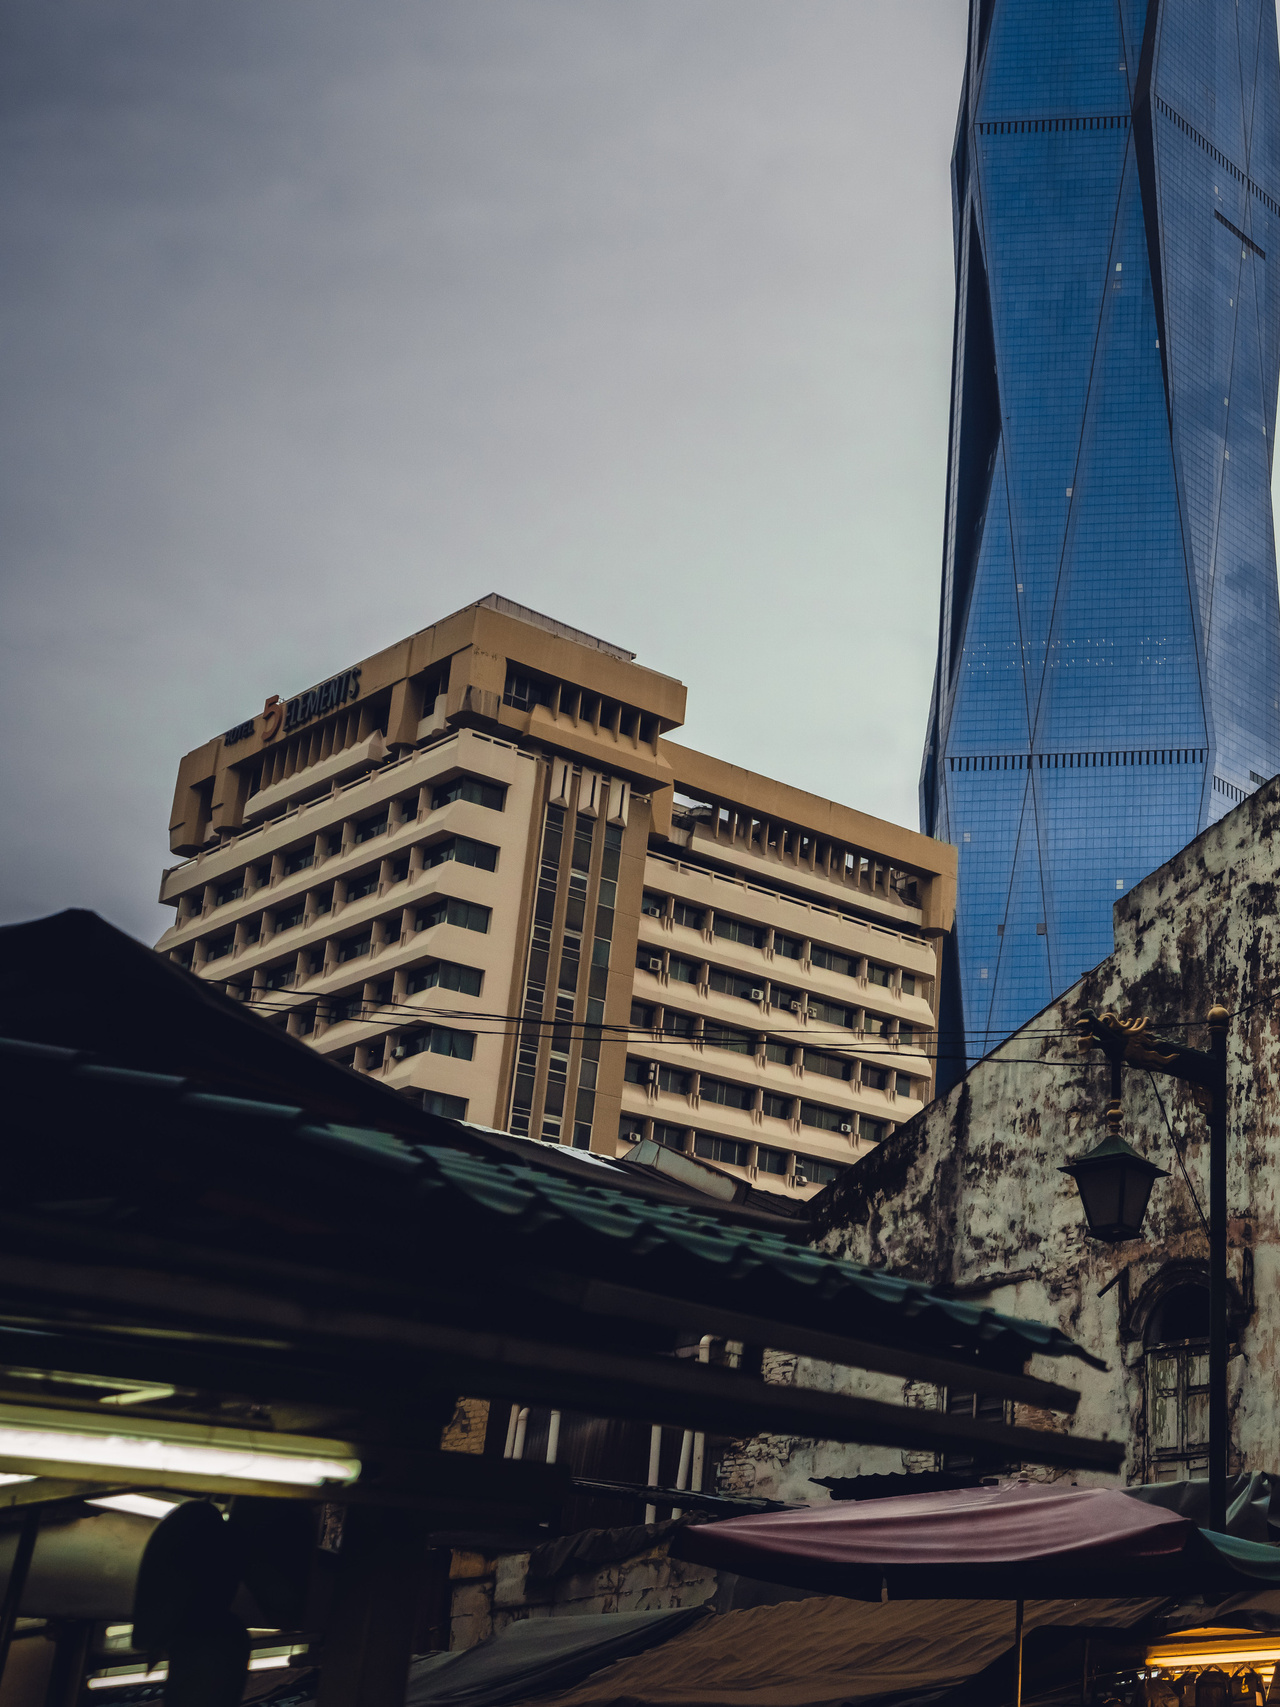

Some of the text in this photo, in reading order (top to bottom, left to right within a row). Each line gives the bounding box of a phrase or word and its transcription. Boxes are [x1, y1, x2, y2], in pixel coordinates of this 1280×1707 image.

[224, 666, 362, 747] HOTEL 5 ELEMENTS
